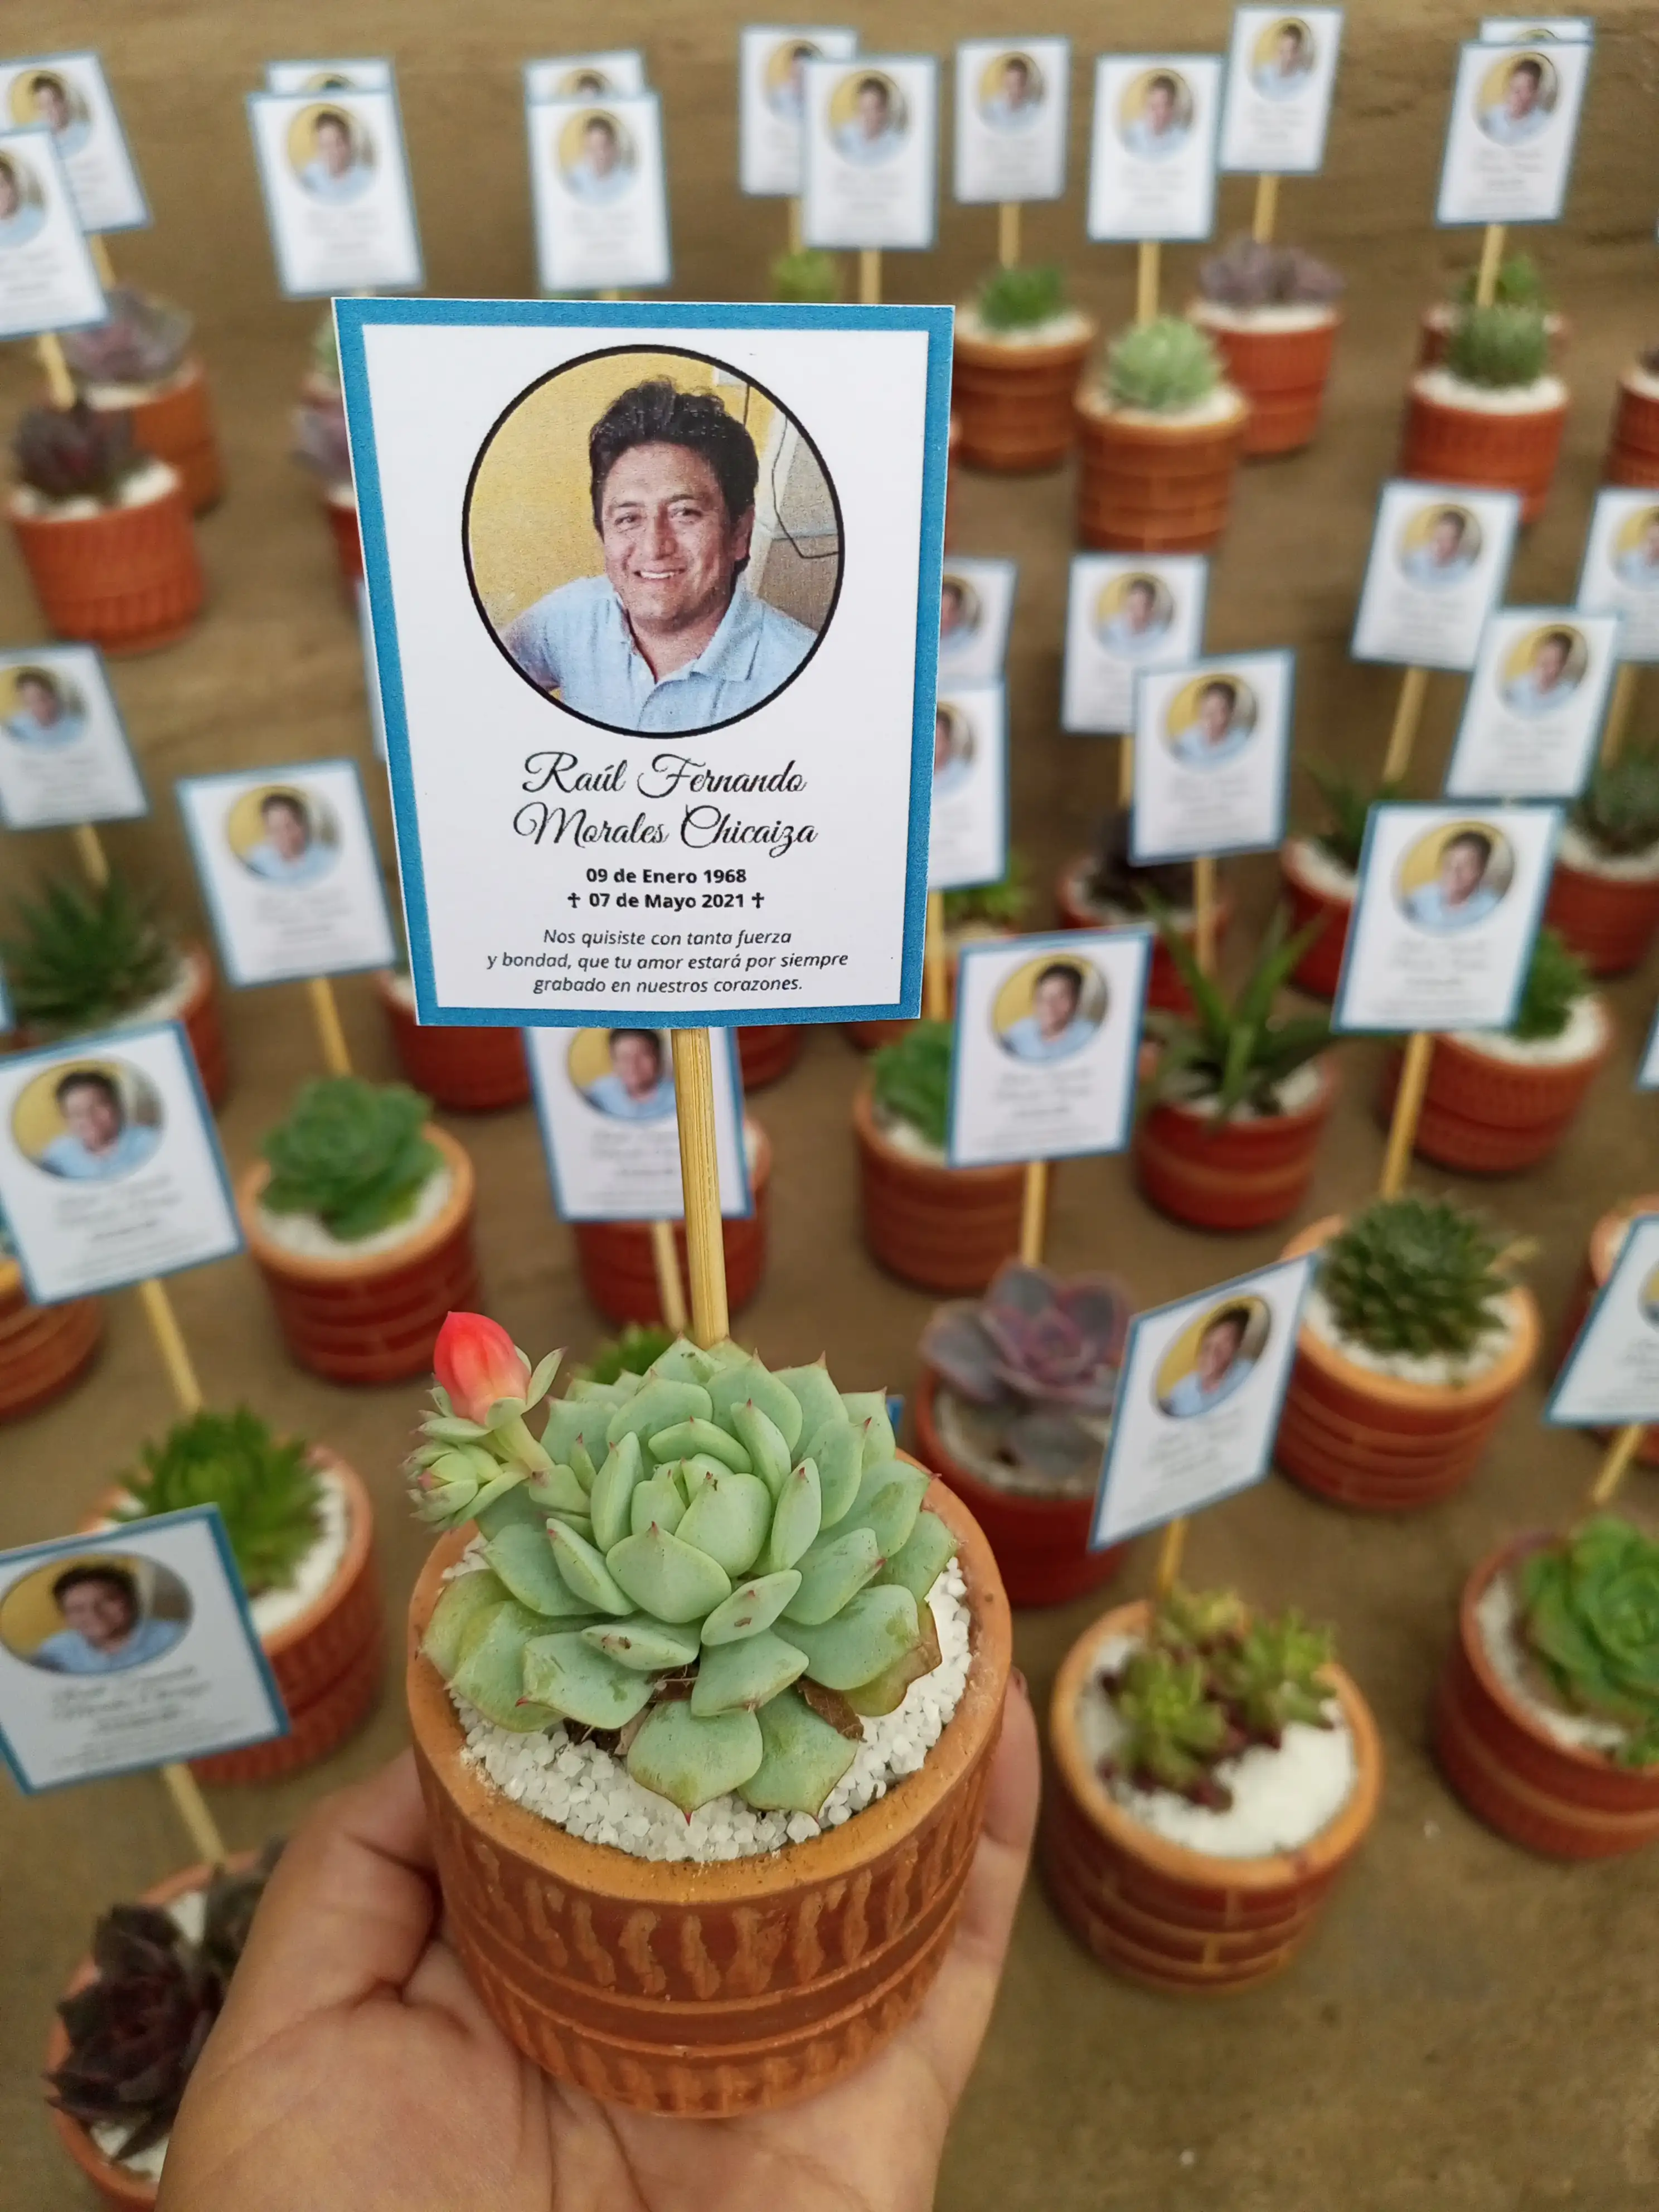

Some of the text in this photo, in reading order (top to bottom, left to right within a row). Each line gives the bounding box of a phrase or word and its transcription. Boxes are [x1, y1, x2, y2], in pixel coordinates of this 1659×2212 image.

[522, 751, 808, 799] Raúl Fernando
[513, 802, 818, 858] Morales Chicaiza
[586, 868, 747, 884] 09 de Enero 1968
[589, 892, 744, 913] 07 de Mayo 2021
[544, 929, 792, 949] Nos quisiste con tanta fuerza
[487, 951, 848, 972] y bondad, que tu amor estará por siempre
[533, 977, 803, 995] grabado en nuestros corazones.
